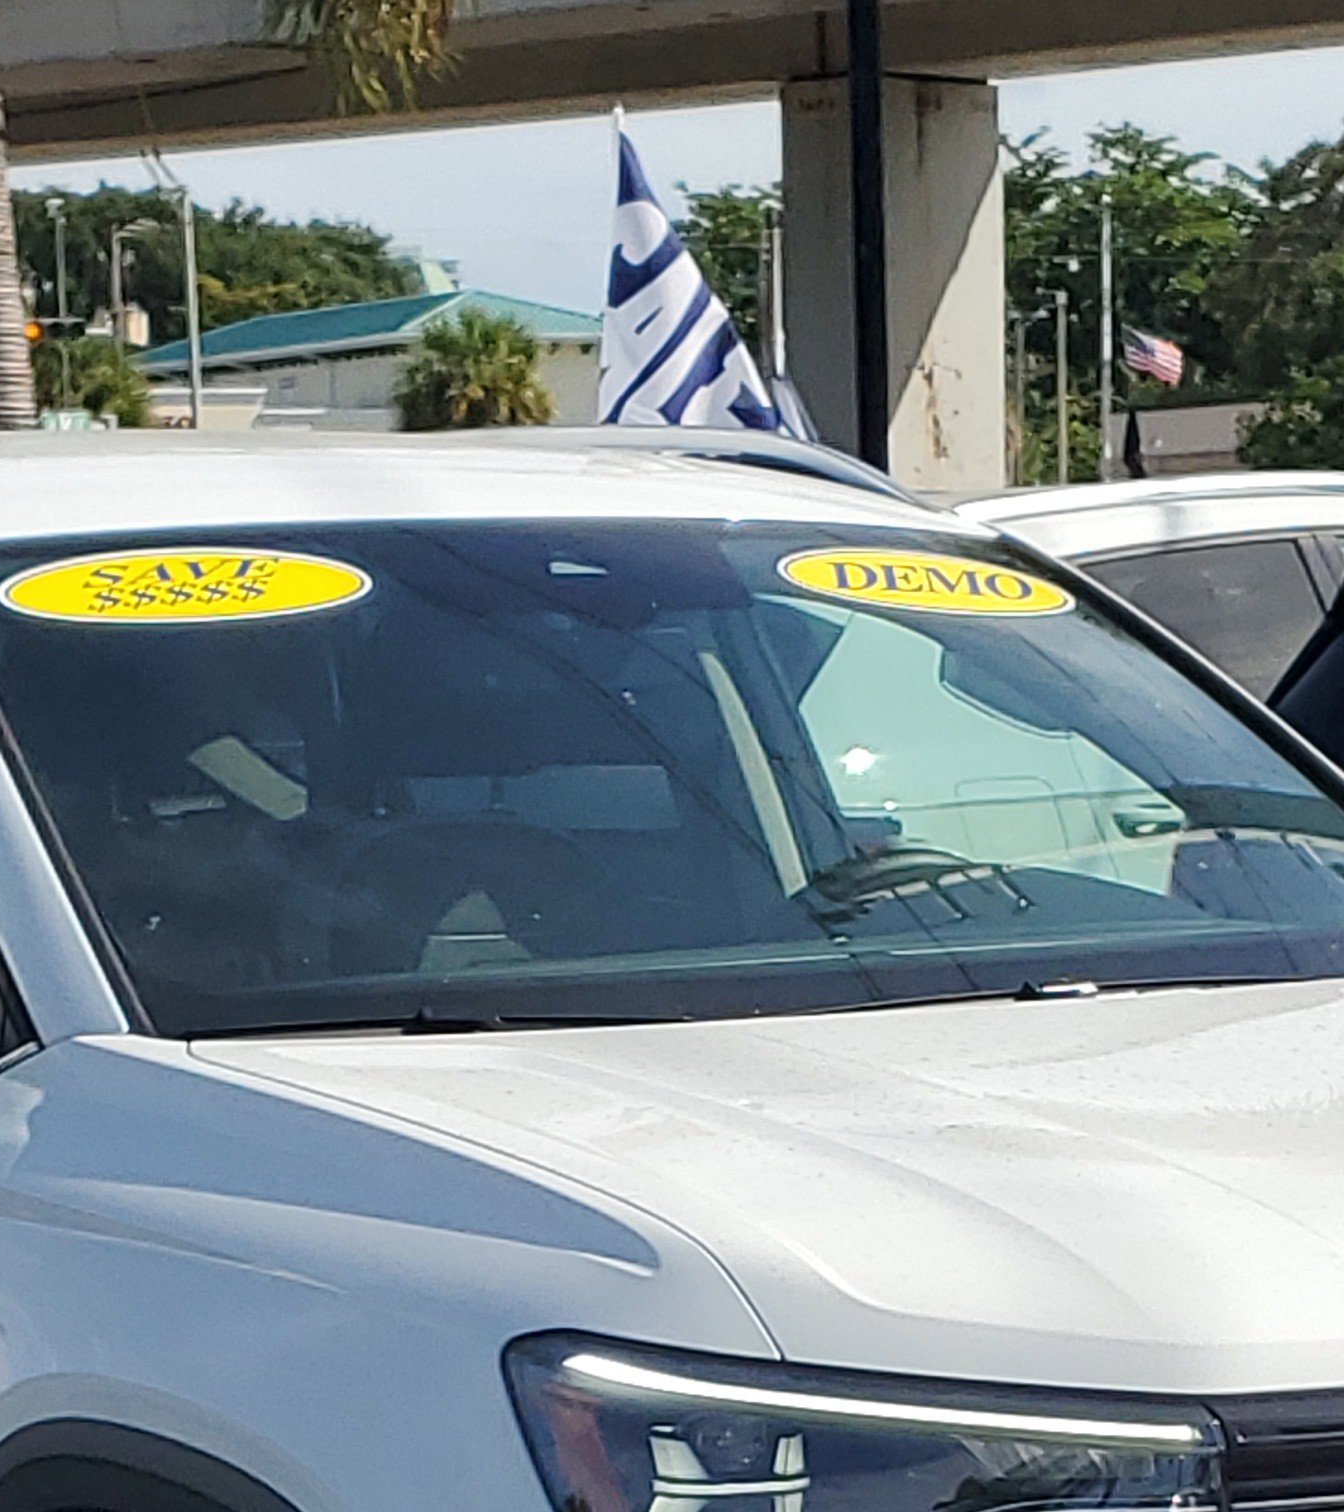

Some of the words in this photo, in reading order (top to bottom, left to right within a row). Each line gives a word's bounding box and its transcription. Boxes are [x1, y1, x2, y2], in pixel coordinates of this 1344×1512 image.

[83, 557, 280, 589] SAVE
[828, 561, 1033, 600] DEMO
[88, 579, 269, 613] $$$$$
